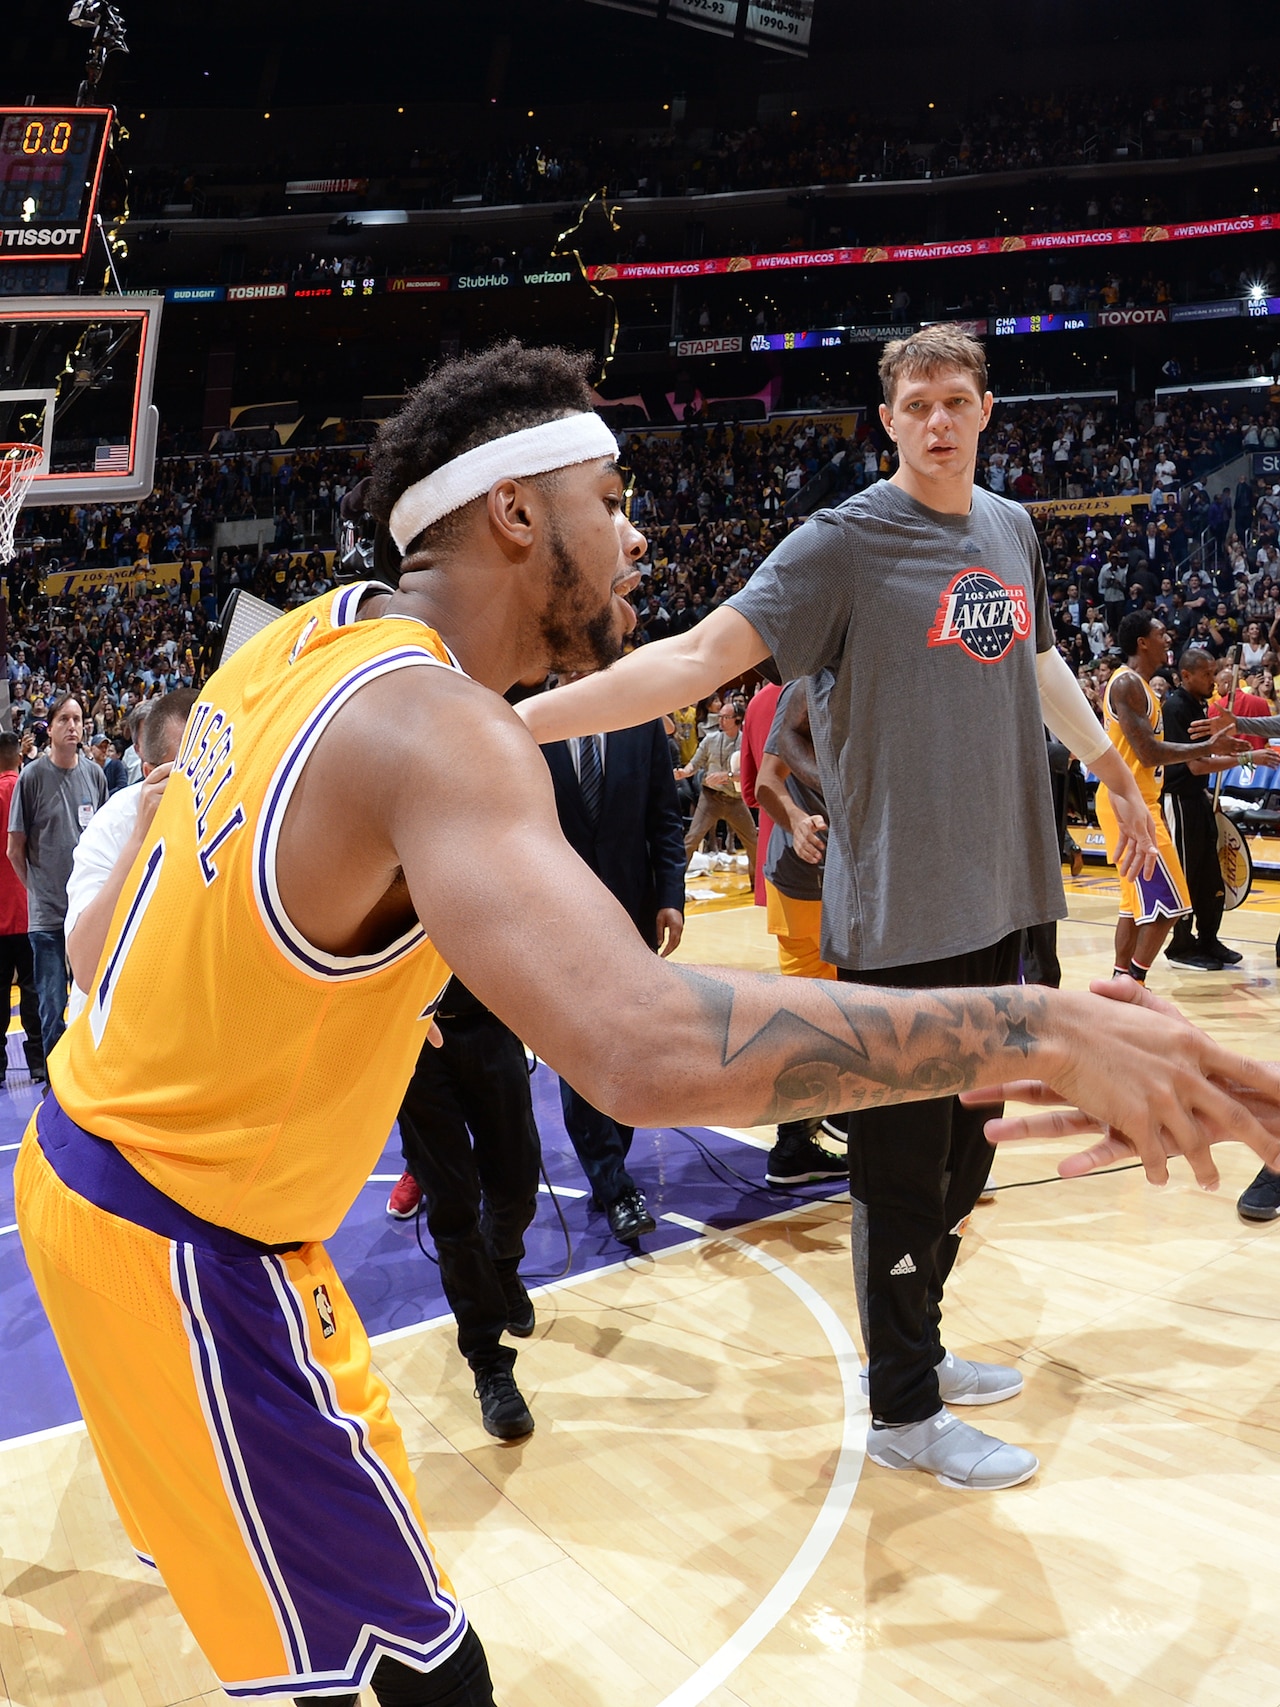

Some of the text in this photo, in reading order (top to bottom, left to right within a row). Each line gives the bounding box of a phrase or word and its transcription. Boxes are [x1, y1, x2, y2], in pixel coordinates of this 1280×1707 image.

[759, 14, 799, 35] 1990-91
[22, 122, 72, 154] 0.0
[1174, 220, 1254, 236] #WEWANTTACOS
[4, 229, 81, 245] TISSOT
[1031, 232, 1112, 246] #WEWANTTACOS
[894, 244, 972, 258] #WEWANTTACOS
[757, 254, 834, 267] #WEWANTTACOS
[623, 264, 700, 276] #WEWANTTACOS
[341, 279, 356, 288] LAL
[363, 279, 374, 287] GS
[458, 276, 509, 288] StubHub
[524, 271, 571, 284] verizon
[174, 290, 215, 298] BUD LIGHT
[229, 285, 286, 298] TOSHIBA
[1099, 310, 1166, 325] TOYOTA
[1249, 307, 1268, 316] TOR
[996, 318, 1016, 327] CHA
[1064, 320, 1084, 329] NBA
[996, 326, 1014, 335] BKN
[679, 338, 740, 355] STAPLES
[822, 337, 842, 346] NBA
[83, 573, 102, 581] LOS
[965, 589, 1024, 600] LOS ANGELES
[934, 594, 1031, 641] LAKERS
[172, 700, 247, 889] USSELL
